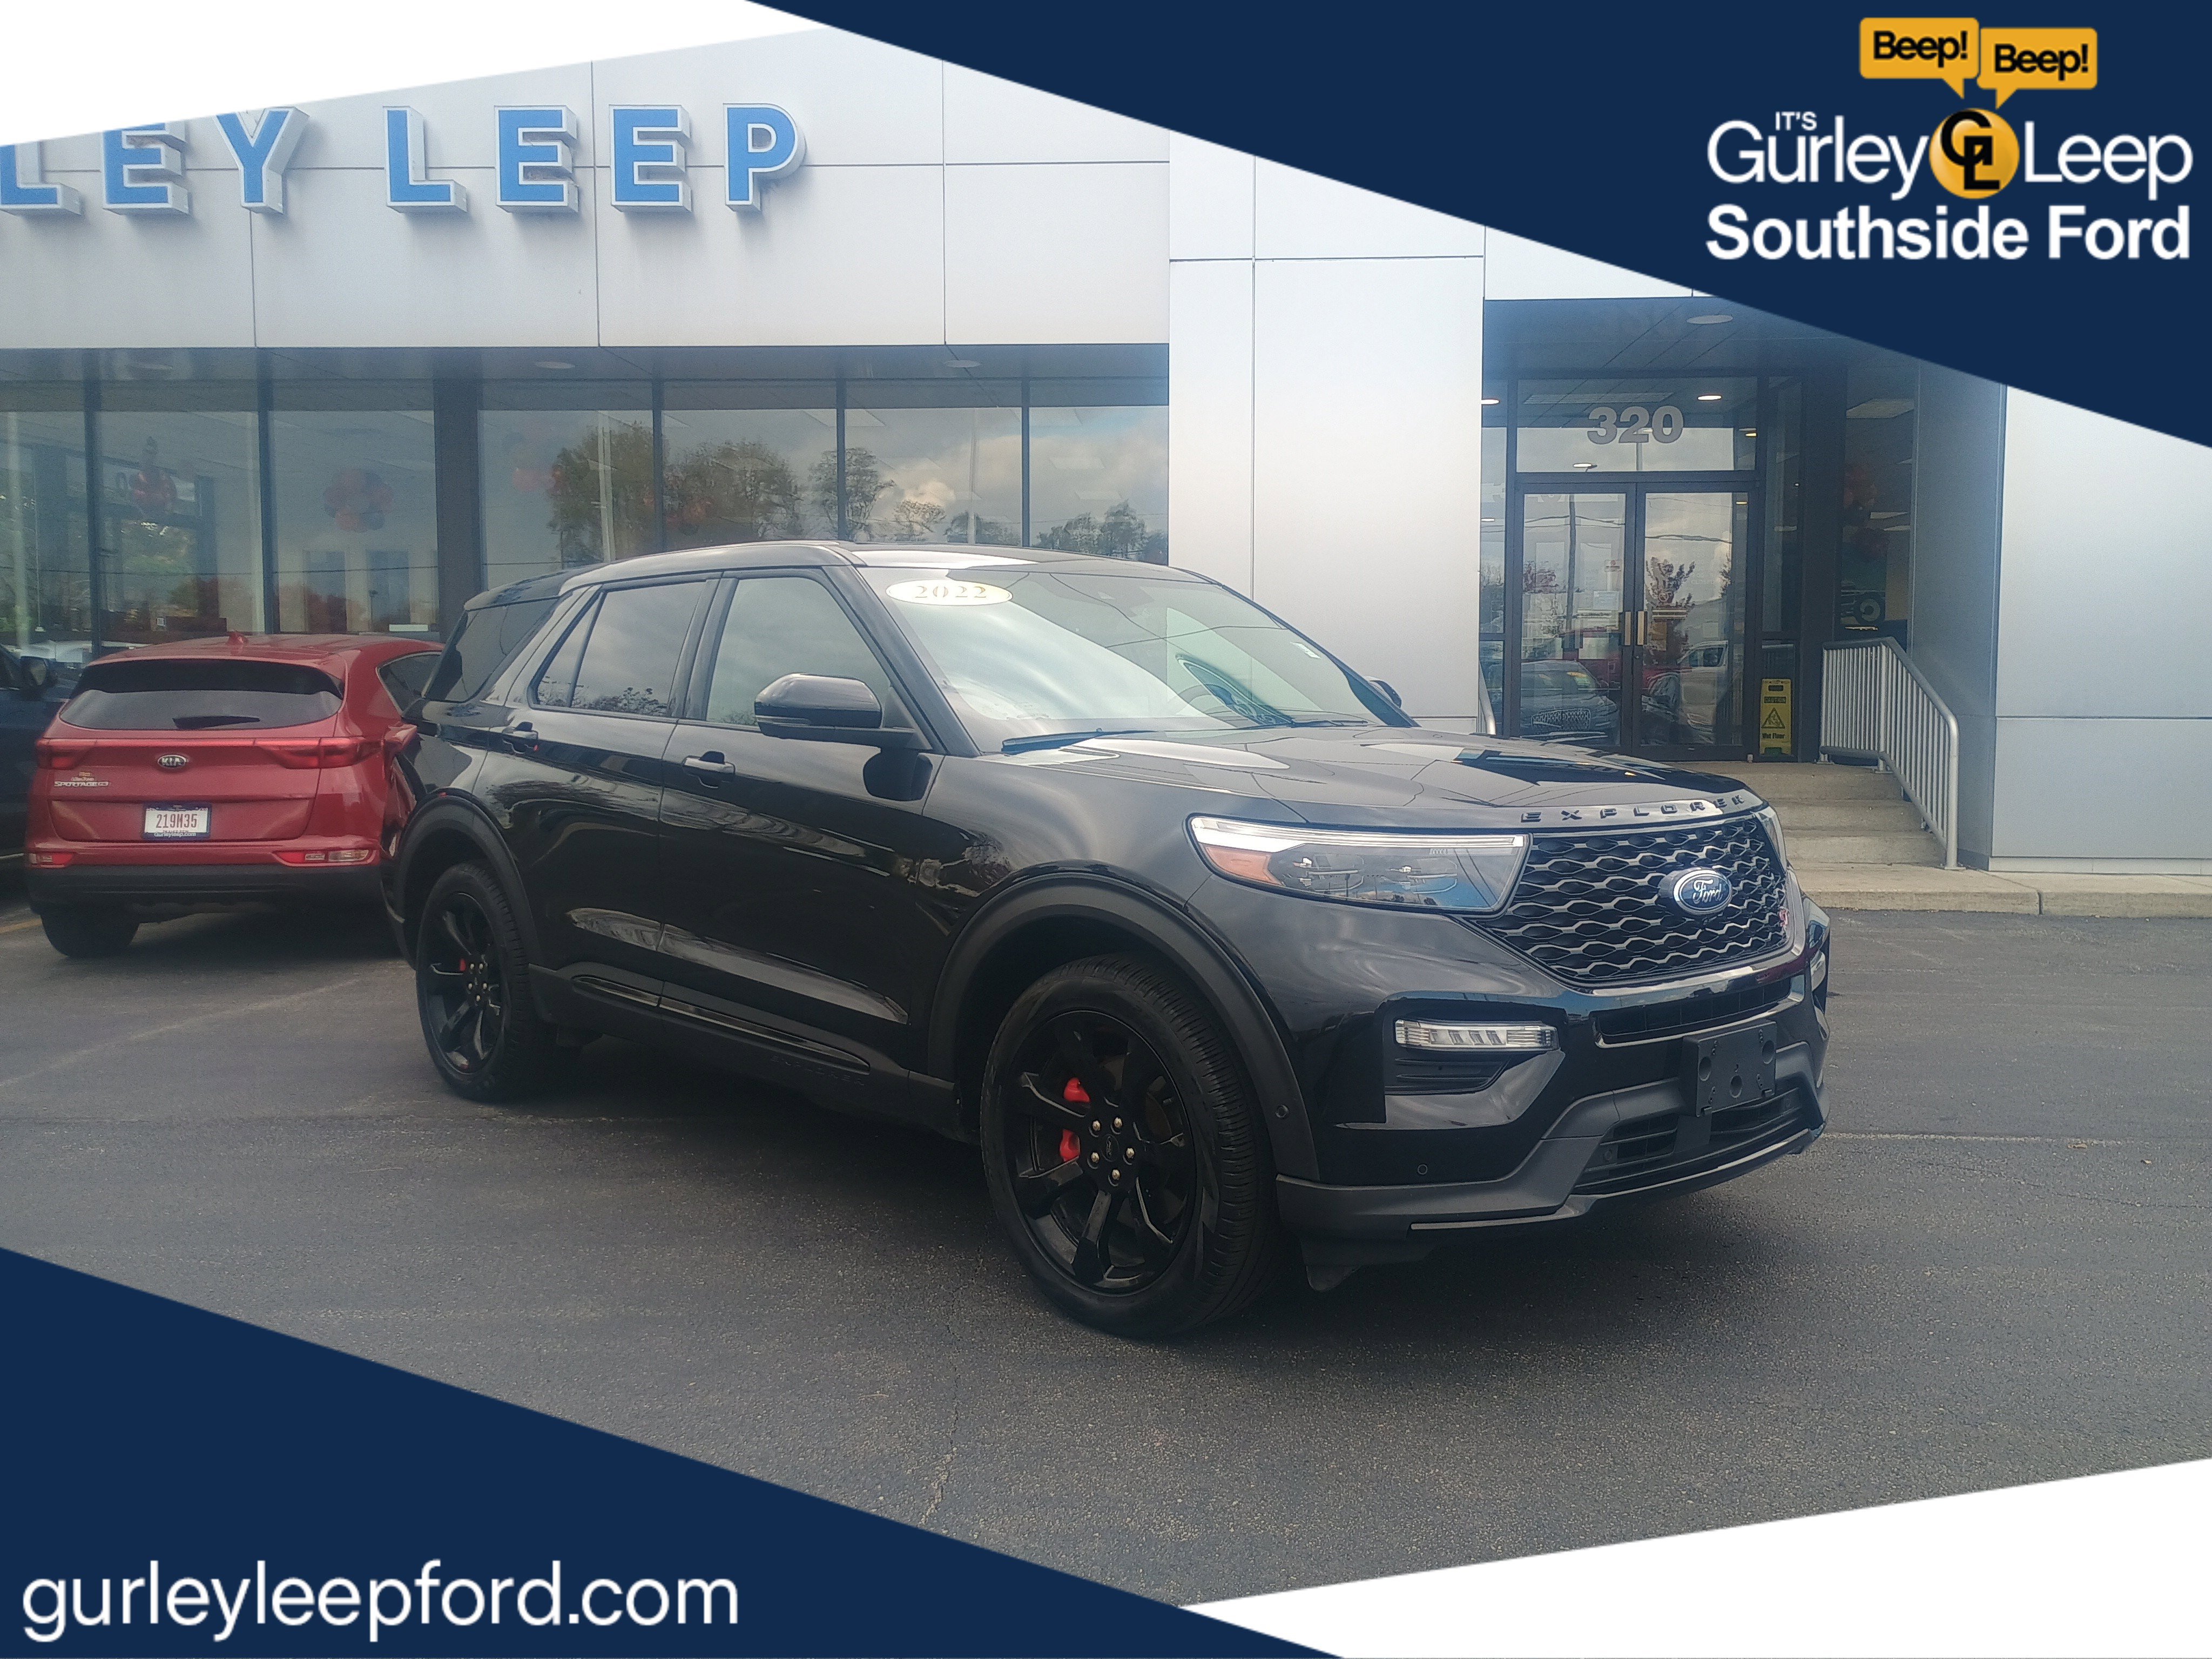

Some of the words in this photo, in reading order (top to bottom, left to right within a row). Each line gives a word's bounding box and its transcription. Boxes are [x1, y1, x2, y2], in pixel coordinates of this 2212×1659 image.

[383, 103, 804, 211] LEEP
[1587, 405, 1683, 445] 320
[915, 585, 987, 598] 2022
[161, 757, 182, 766] KIA
[1521, 794, 1745, 823] EXPLORER
[1692, 879, 1723, 904] Ford
